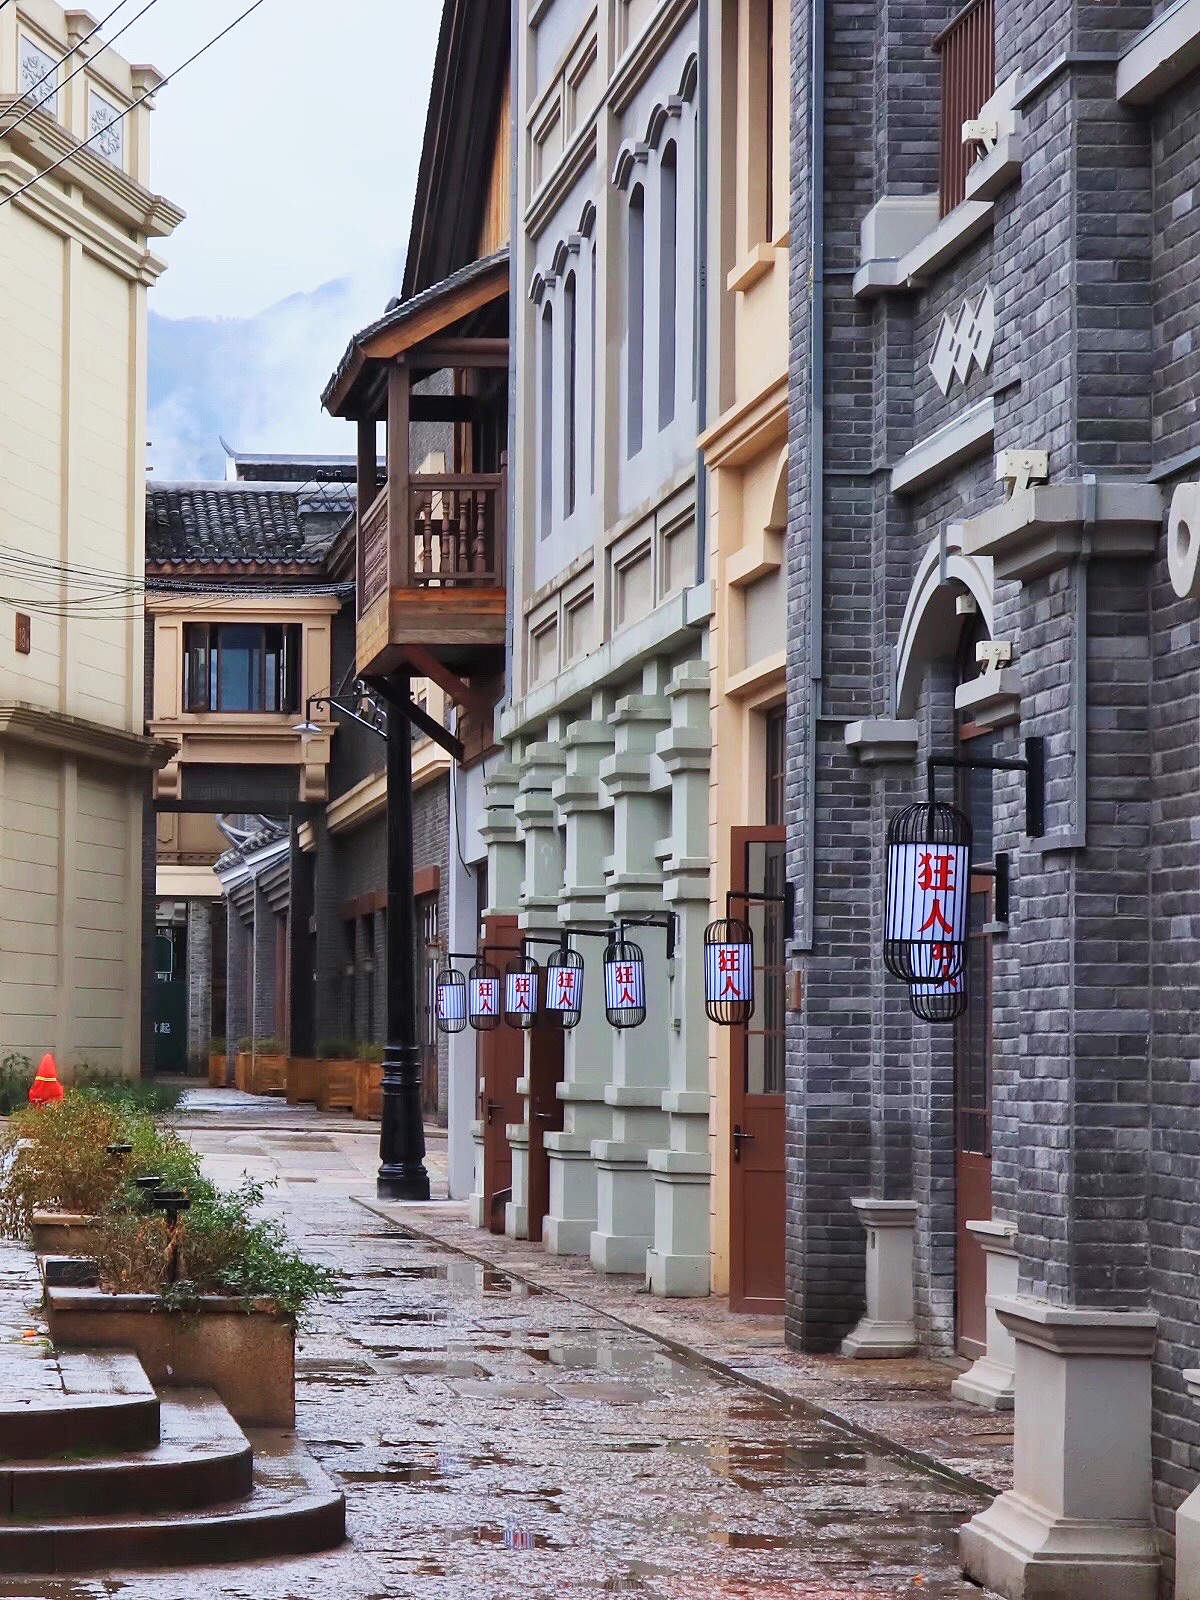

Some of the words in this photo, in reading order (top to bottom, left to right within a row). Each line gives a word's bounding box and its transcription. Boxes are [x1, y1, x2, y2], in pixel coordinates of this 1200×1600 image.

[917, 852, 956, 935] 狂人
[557, 970, 575, 1007] 狂人
[615, 965, 636, 1005] 狂人
[718, 949, 741, 997] 狂人
[480, 982, 492, 1012] 狂人
[515, 977, 530, 1011] 狂人
